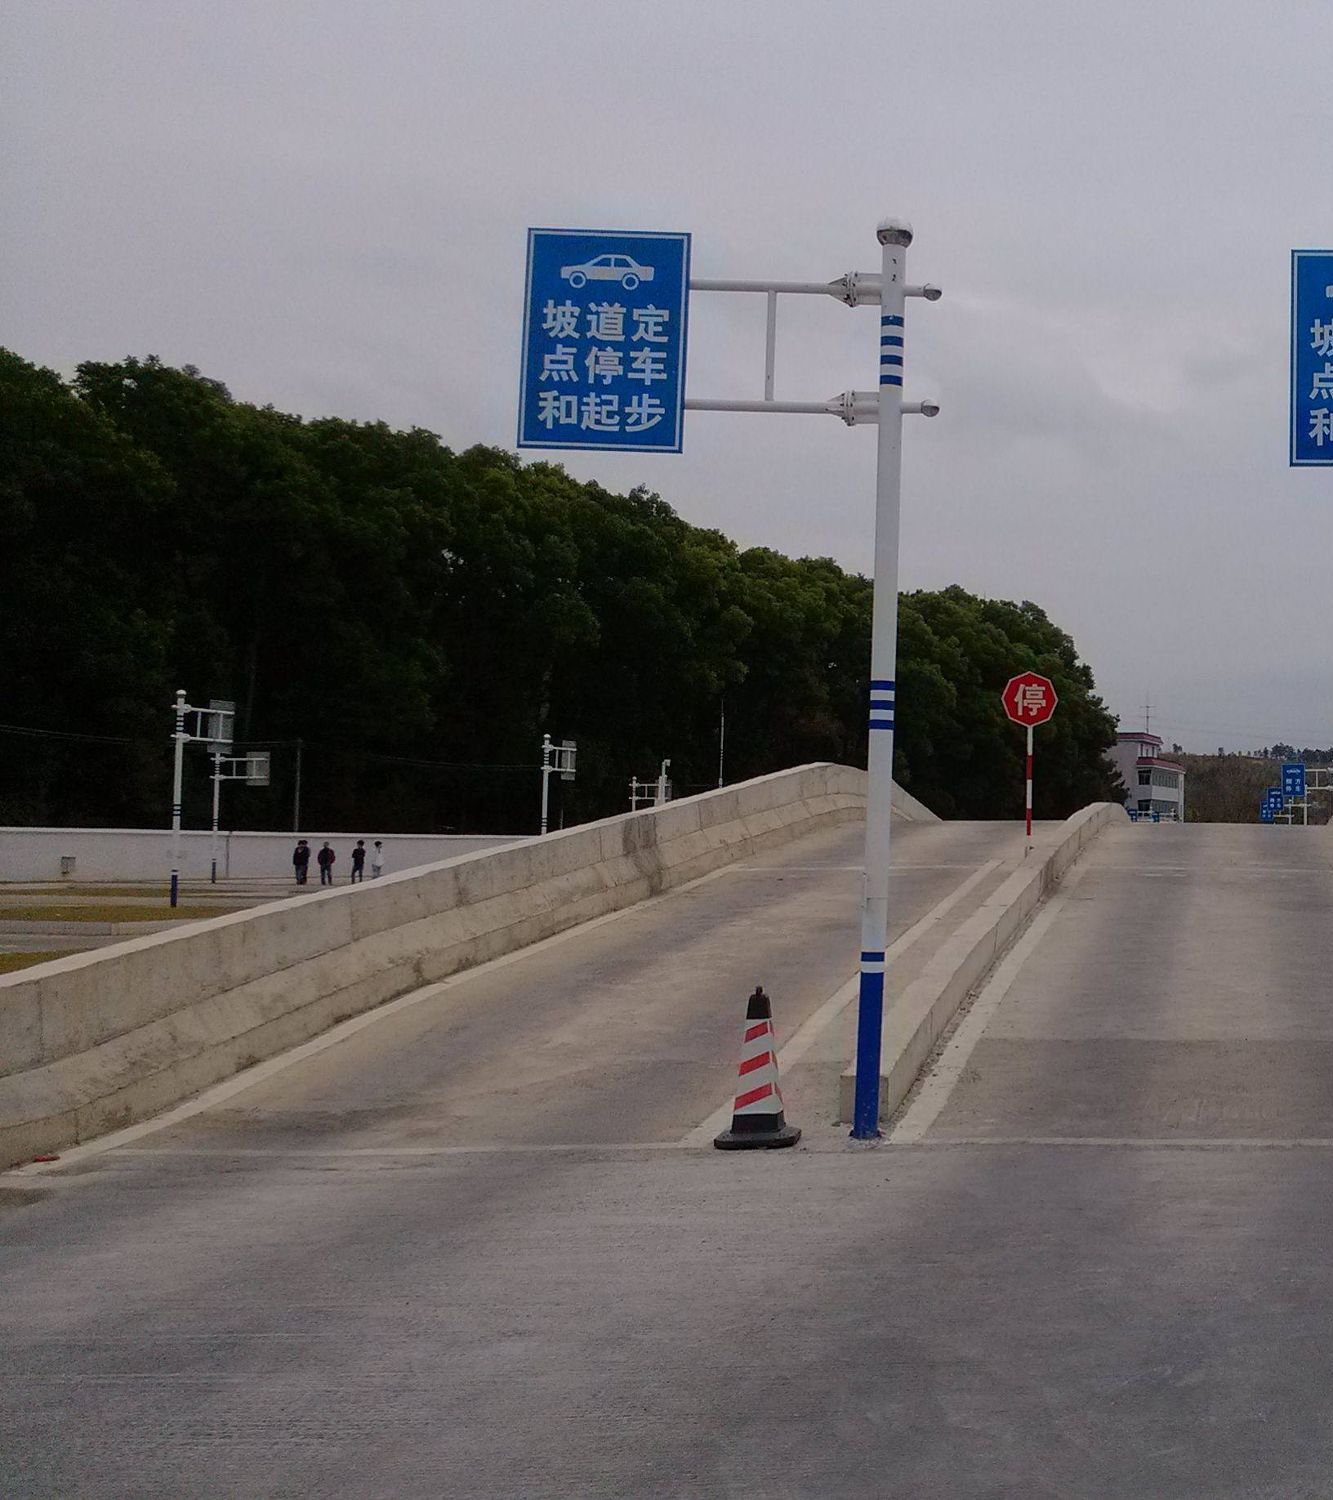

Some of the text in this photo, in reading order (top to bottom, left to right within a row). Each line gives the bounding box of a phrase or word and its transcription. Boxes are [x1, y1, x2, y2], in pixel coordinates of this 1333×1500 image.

[542, 300, 669, 343] 坡道定
[538, 344, 667, 385] 点停车
[537, 390, 666, 432] 和起步
[1014, 683, 1046, 716] 停
